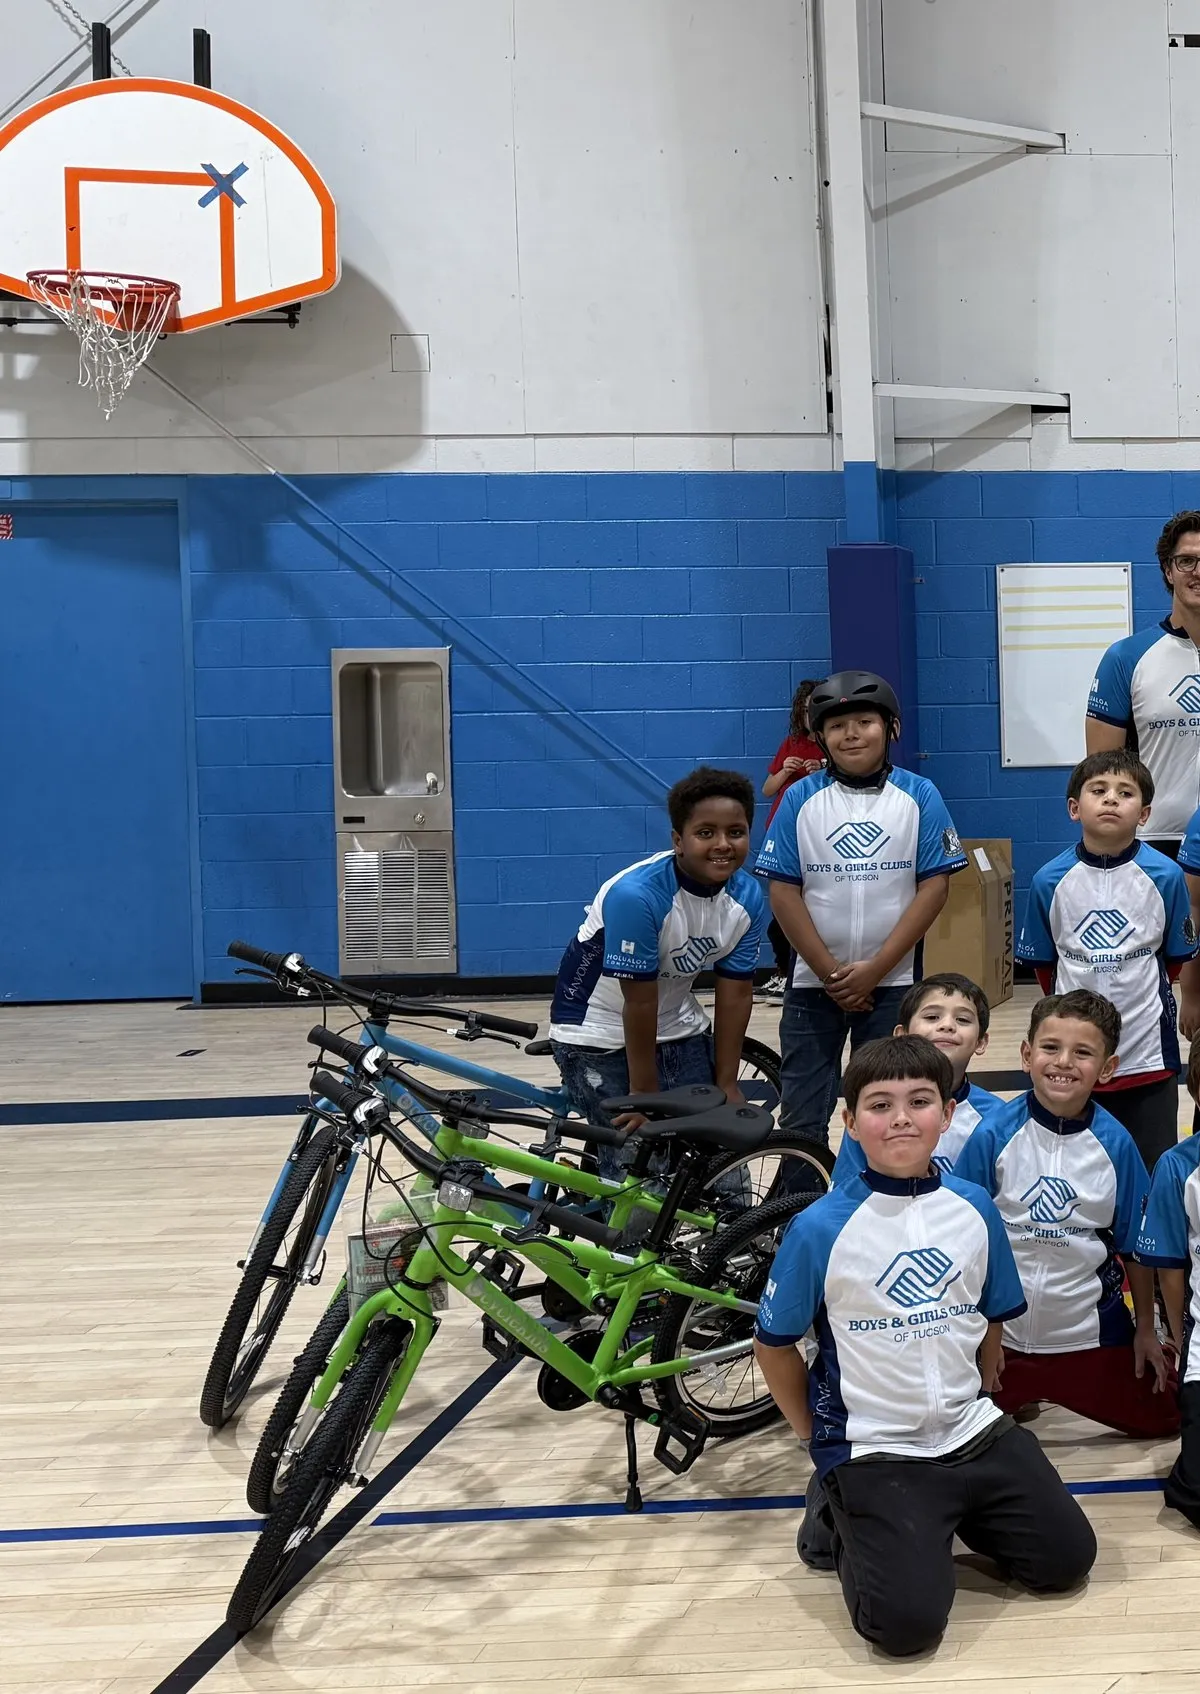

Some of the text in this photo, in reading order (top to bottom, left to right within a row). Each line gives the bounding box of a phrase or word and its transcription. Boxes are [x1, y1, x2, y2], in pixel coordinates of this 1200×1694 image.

[1149, 719, 1176, 730] BOYS
[1178, 718, 1186, 726] &
[806, 860, 912, 872] BOYS & GIRLS CLUBS
[848, 874, 879, 882] TUCSON
[1004, 880, 1012, 996] PRIMAL
[606, 954, 647, 966] HOLUALOA
[1090, 954, 1122, 964] GIRLS
[1124, 947, 1152, 961] CLUBS
[1034, 1227, 1065, 1238] GIRLS
[848, 1317, 888, 1332] BOYS
[892, 1316, 904, 1328] &
[908, 1308, 948, 1326] GIRLS
[894, 1324, 950, 1343] OF TUCSON
